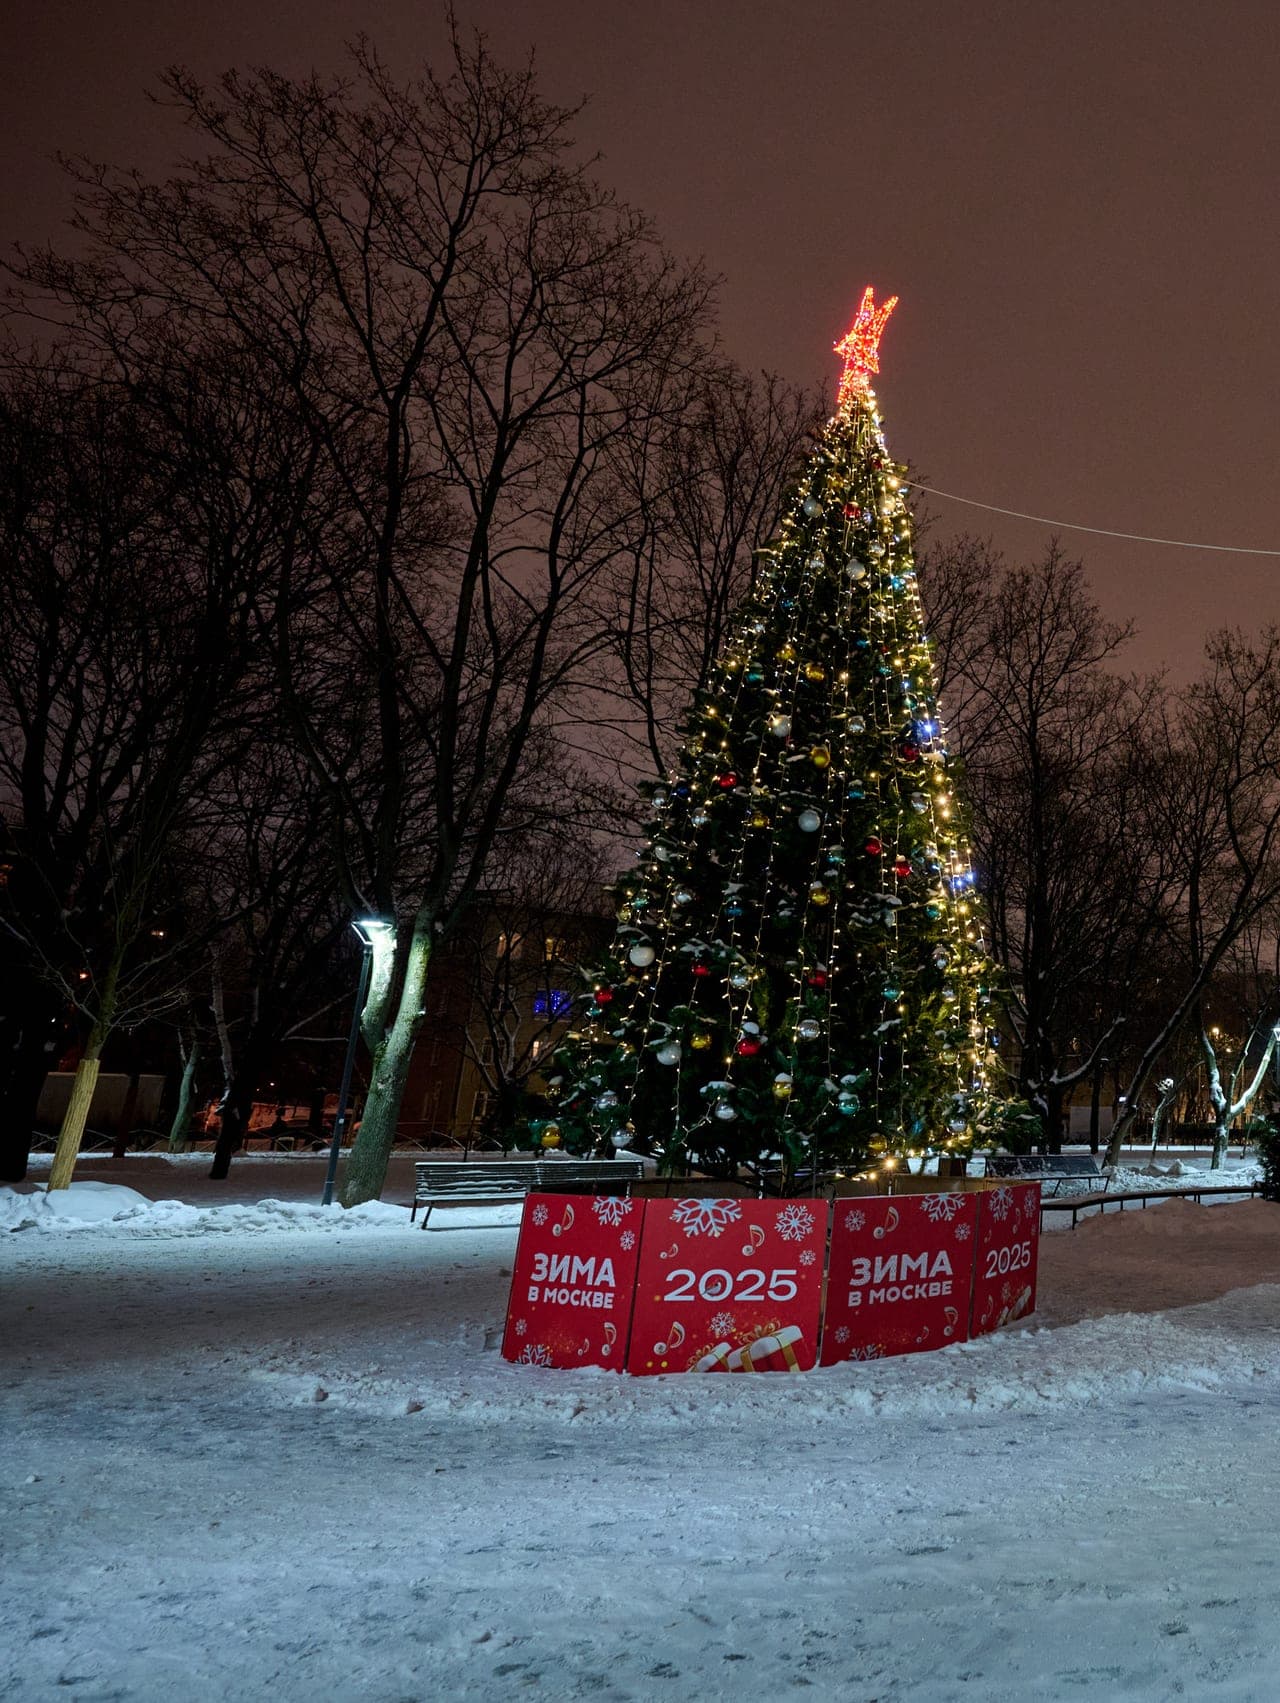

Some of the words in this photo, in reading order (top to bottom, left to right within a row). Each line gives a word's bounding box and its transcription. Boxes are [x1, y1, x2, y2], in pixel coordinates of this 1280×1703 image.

[530, 1253, 616, 1287] ЗИМА
[849, 1250, 953, 1287] ЗИМА
[985, 1241, 1031, 1279] 2025
[528, 1286, 539, 1302] В
[543, 1287, 615, 1309] МОСКВЕ
[663, 1268, 798, 1302] 2025
[847, 1291, 861, 1307] В
[868, 1280, 953, 1305] МОСКВЕ
